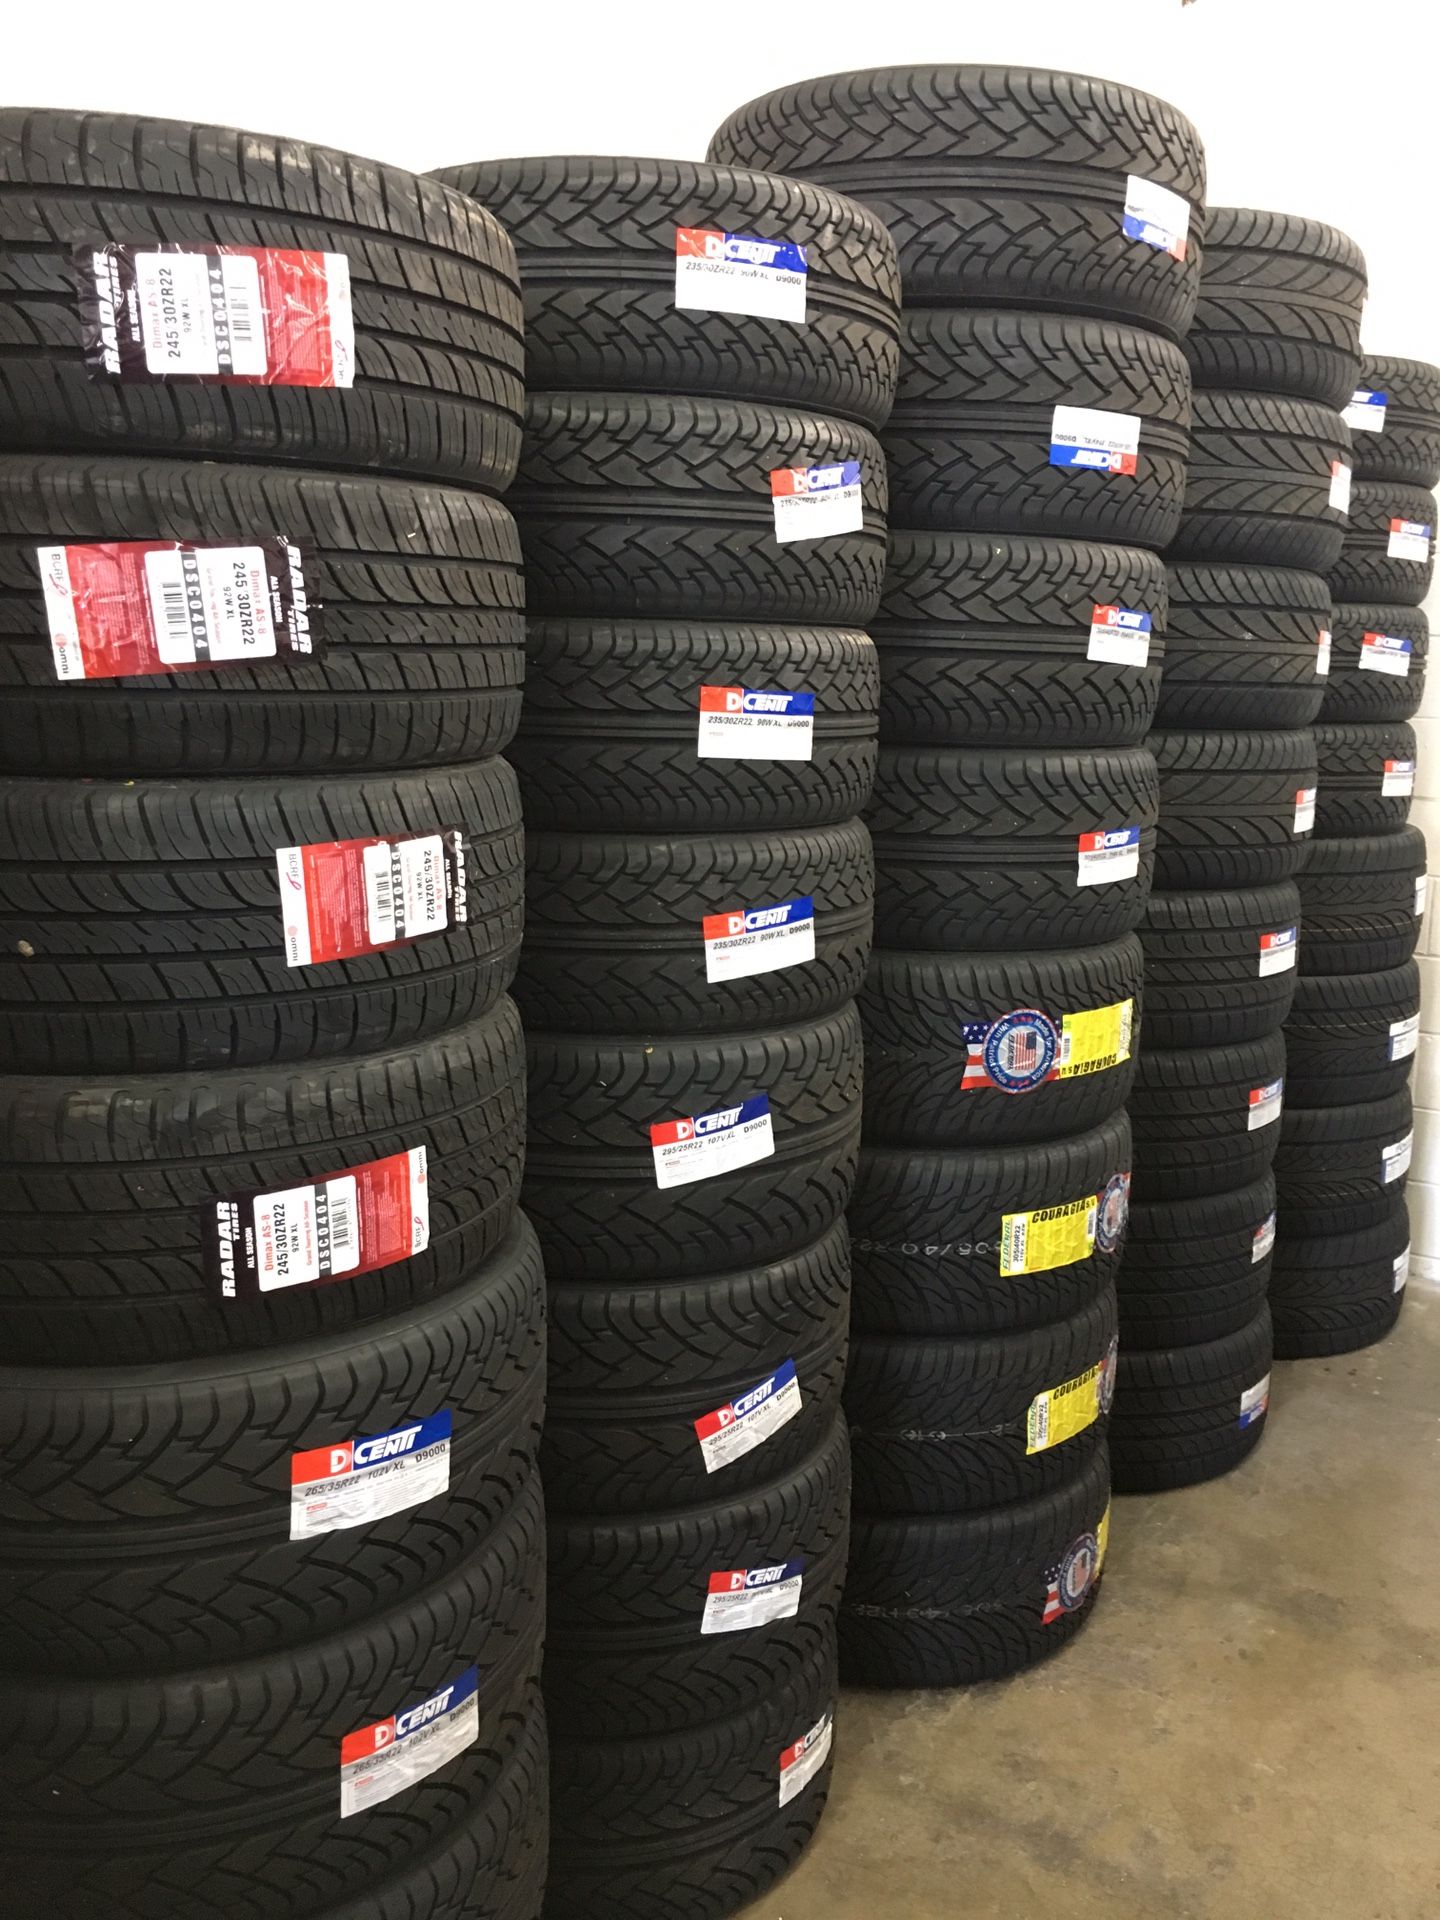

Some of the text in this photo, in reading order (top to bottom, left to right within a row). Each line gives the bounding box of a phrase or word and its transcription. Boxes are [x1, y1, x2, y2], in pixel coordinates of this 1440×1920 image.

[109, 256, 122, 306] TIRES
[93, 252, 121, 374] RADAR
[158, 268, 181, 358] 245/30ZR22
[209, 268, 231, 365] DSC0404
[183, 559, 208, 649] DSC0404
[287, 545, 312, 654] RADAR
[287, 609, 298, 651] TIRES
[708, 716, 752, 725] 235/30ZR22
[391, 853, 405, 928] DSC0404
[424, 850, 435, 921] 245/30ZR22
[453, 831, 467, 922] RADAR
[713, 936, 756, 950] 235/30ZR22
[1073, 1053, 1117, 1075] COURAGIA
[662, 1141, 703, 1156] 295/25R22
[744, 1119, 767, 1133] D9000
[231, 1203, 240, 1241] TIRES
[291, 1223, 299, 1253] 92W XL
[316, 1194, 330, 1270] DSC0404
[1032, 1200, 1085, 1223] COURAGIA
[216, 1201, 236, 1297] RADAR
[245, 1227, 255, 1268] ALL SEASON
[264, 1241, 273, 1271] Dimax
[273, 1203, 289, 1276] 245/30ZR22
[305, 1444, 445, 1497] 265/35R22 102V XL D9000
